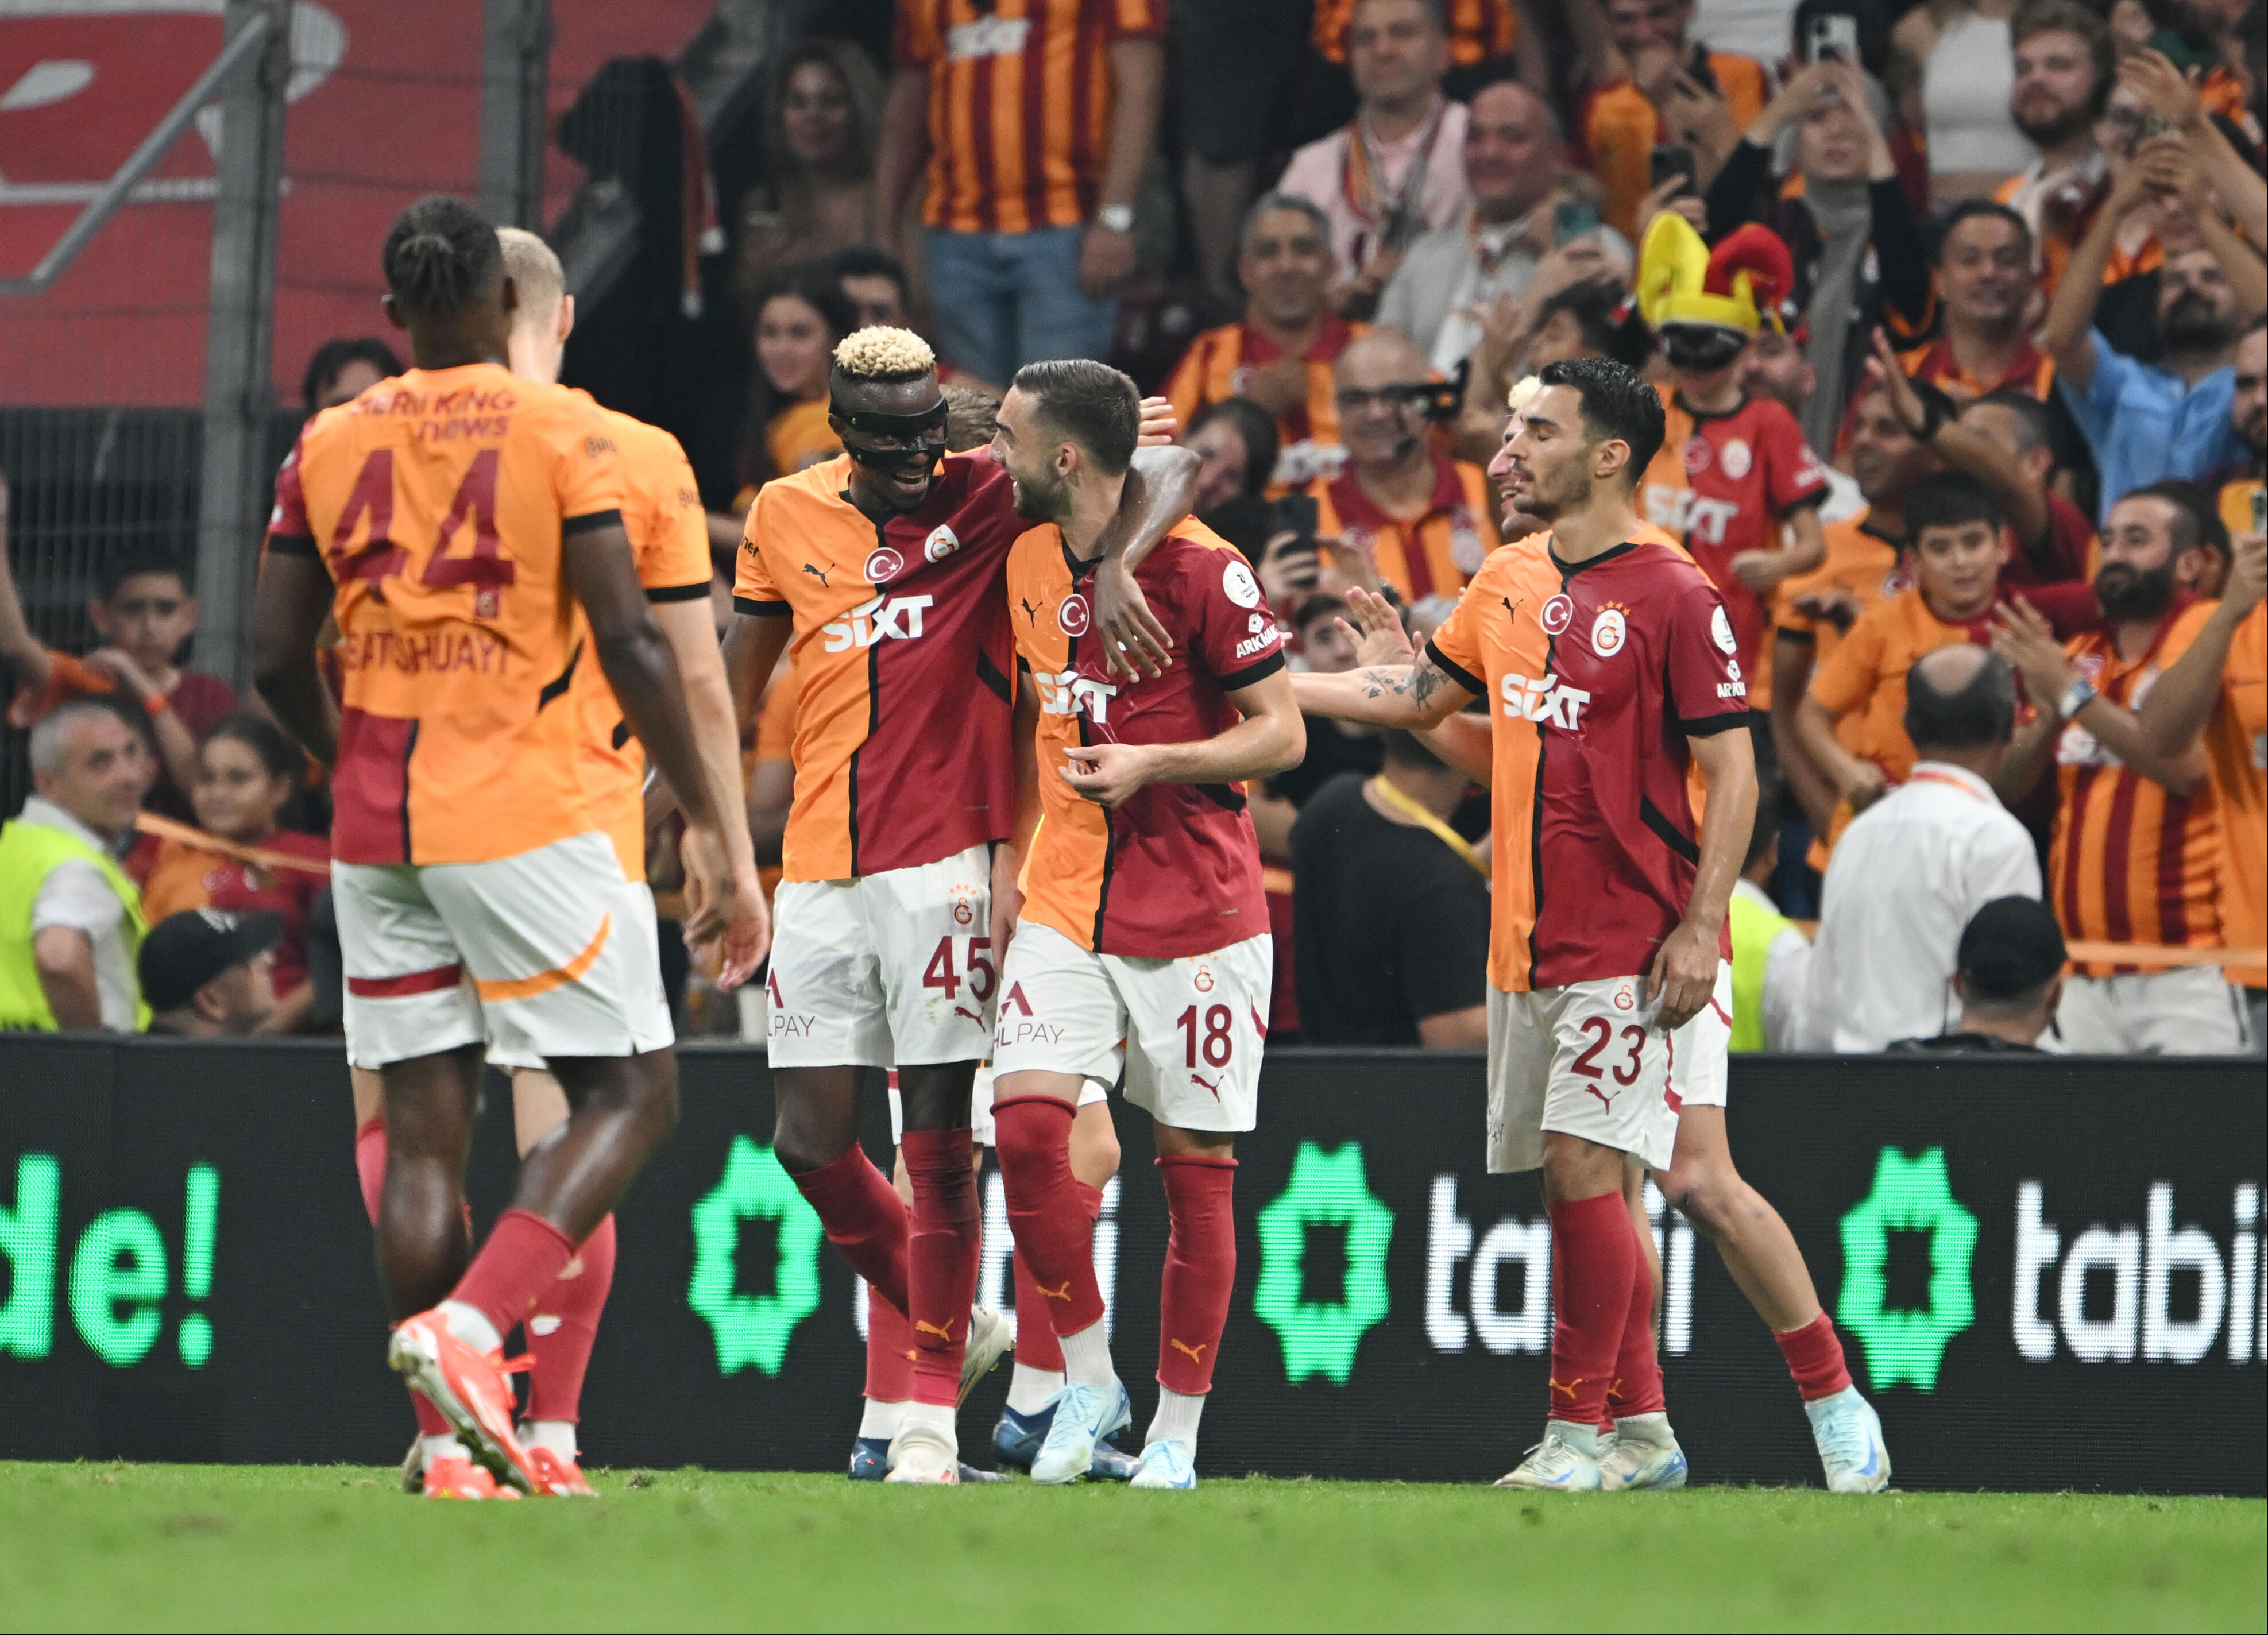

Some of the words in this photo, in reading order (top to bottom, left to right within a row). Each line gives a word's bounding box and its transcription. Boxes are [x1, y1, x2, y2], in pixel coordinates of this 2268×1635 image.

[330, 449, 515, 619] 44
[922, 936, 995, 1003] 45
[1177, 1004, 1232, 1068] 18
[1570, 1016, 1647, 1087] 23
[2012, 1177, 2268, 1365] tabi
